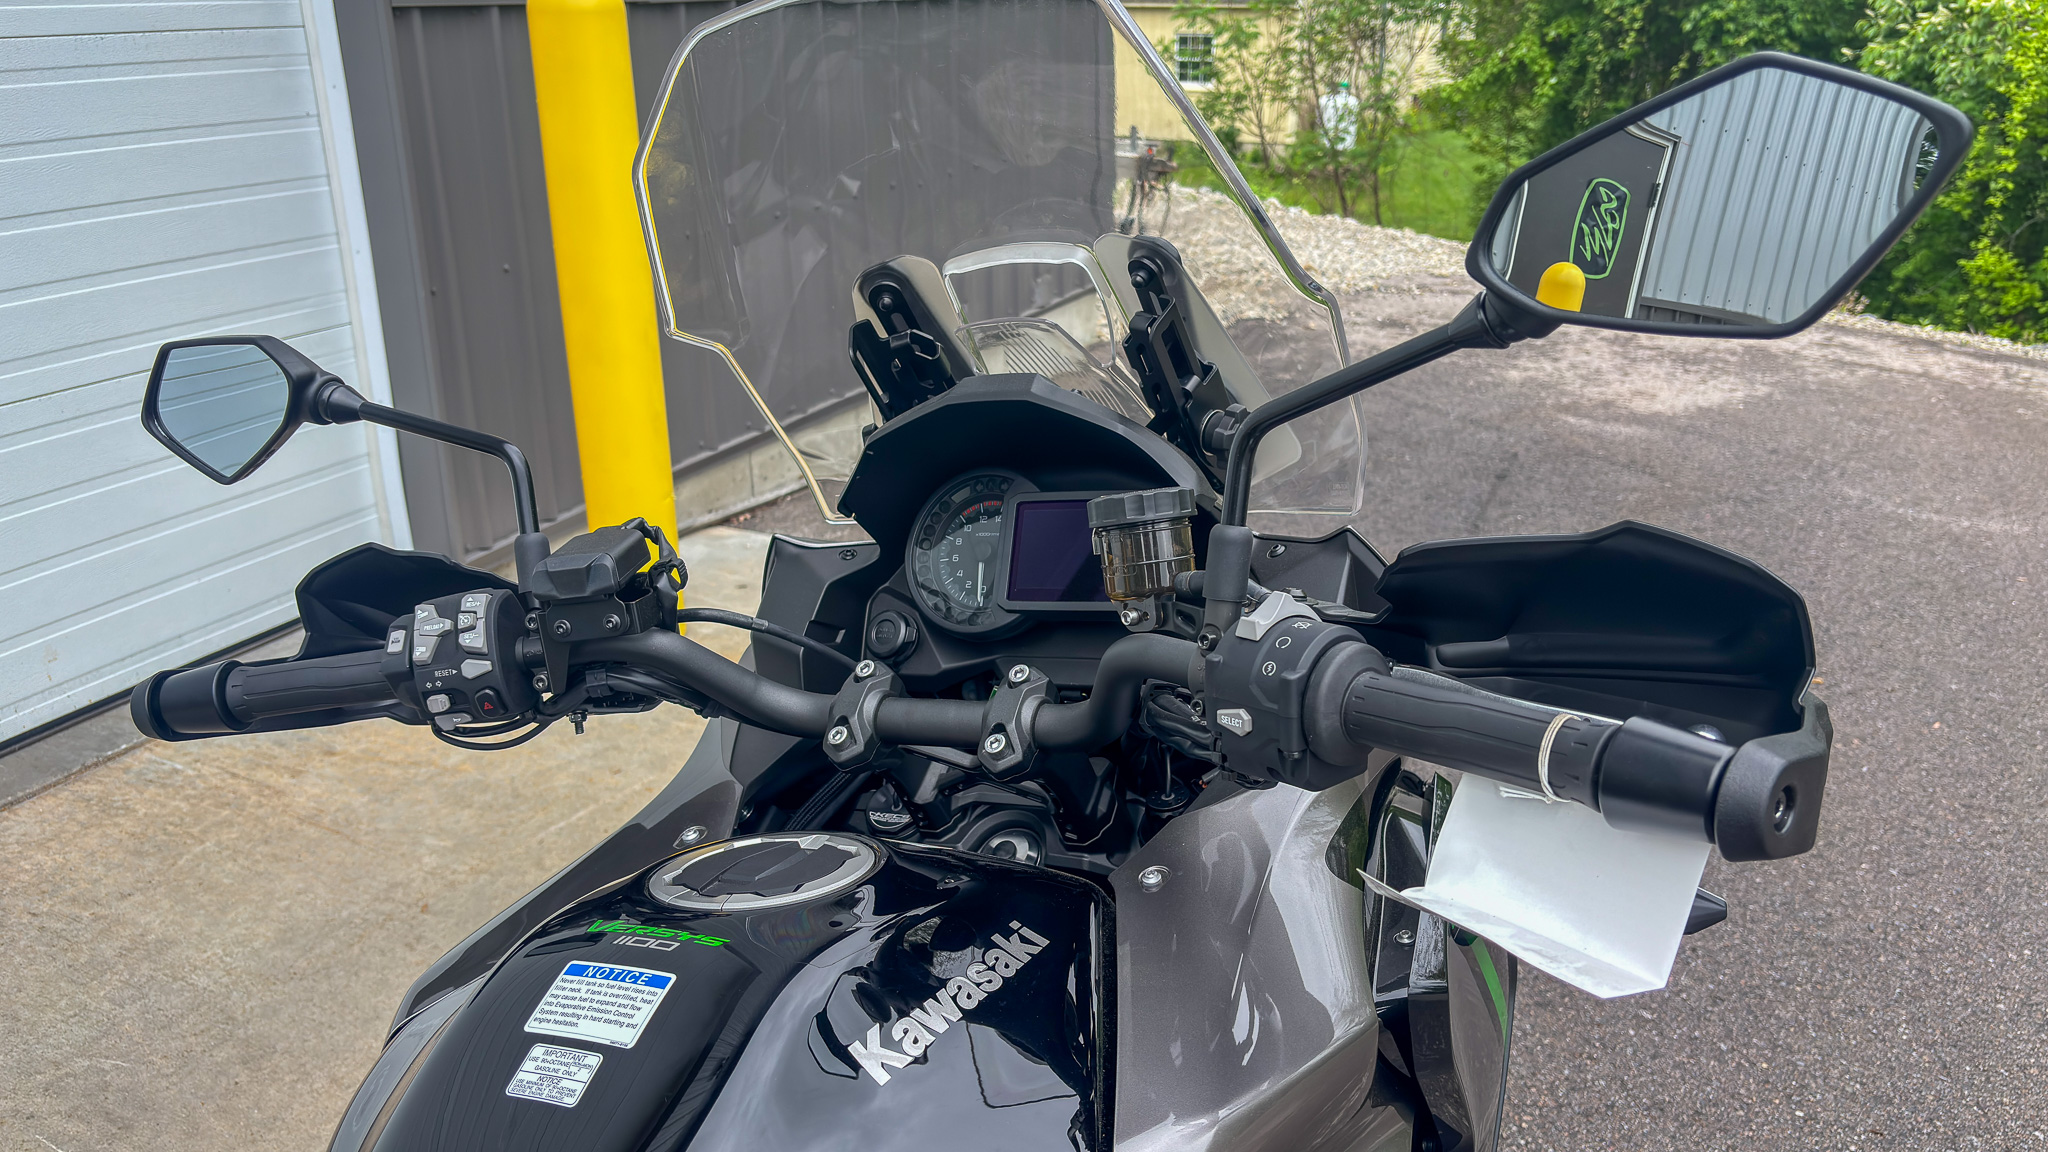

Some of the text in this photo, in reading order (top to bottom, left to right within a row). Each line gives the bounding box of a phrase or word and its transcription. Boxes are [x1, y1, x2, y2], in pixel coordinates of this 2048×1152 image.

[979, 515, 988, 523] 12
[952, 554, 959, 562] 6
[965, 581, 972, 589] 2
[434, 669, 452, 677] RESET
[1220, 715, 1243, 728] SELECT
[587, 919, 731, 947] VERSYS
[612, 935, 681, 951] 1100
[582, 966, 653, 985] NOTICE
[617, 984, 631, 992] level
[646, 989, 658, 997] into
[595, 999, 617, 1007] expand
[617, 1001, 629, 1009] and
[639, 997, 654, 1005] heat
[847, 919, 1050, 1087] Kawasaki
[554, 1001, 586, 1011] Evaporative
[586, 1005, 612, 1015] Emission
[612, 1009, 635, 1019] Control
[551, 1018, 578, 1027] hesitation.
[559, 1011, 582, 1020] resulting
[603, 1018, 625, 1028] starting
[625, 1022, 639, 1030] and
[541, 1049, 588, 1062] IMPORTANT
[534, 1064, 577, 1077] GASOLINE ONLY
[536, 1075, 563, 1085] NOTICE
[555, 1090, 577, 1099] PREVENT
